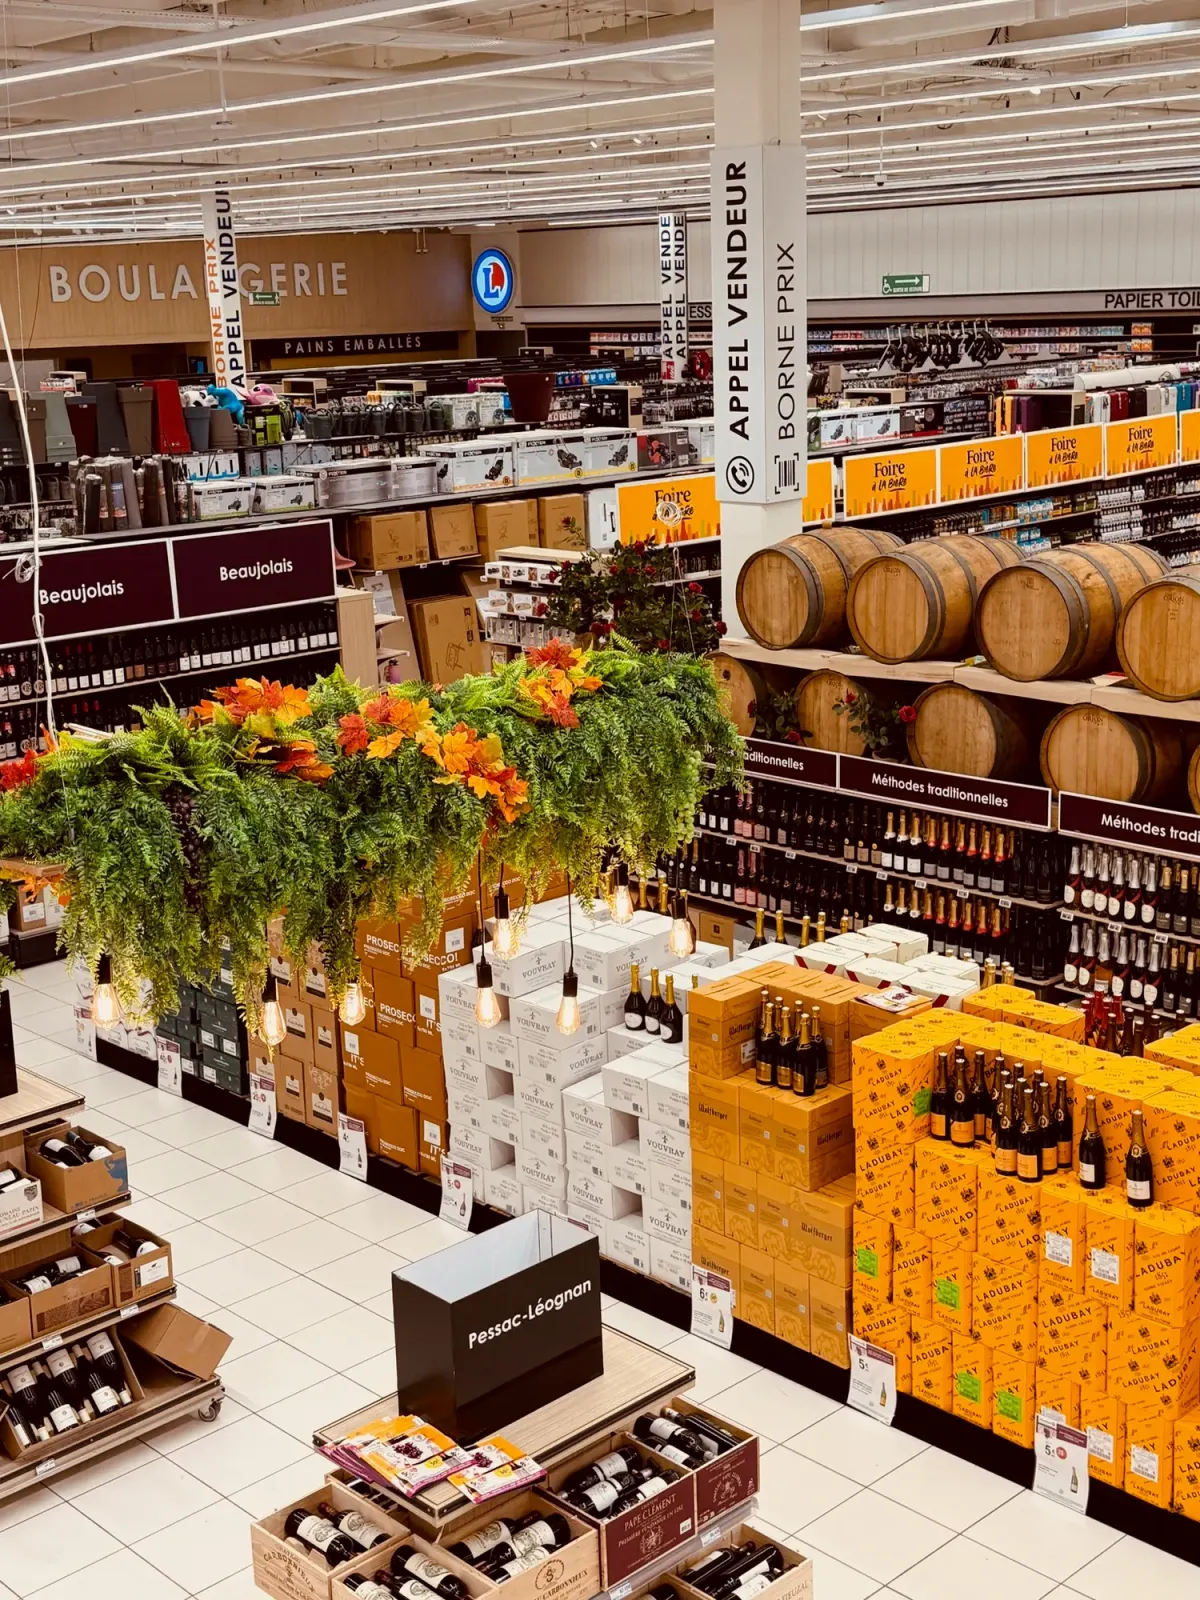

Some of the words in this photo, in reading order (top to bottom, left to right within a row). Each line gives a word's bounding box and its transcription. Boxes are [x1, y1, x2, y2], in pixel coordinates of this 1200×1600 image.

[214, 180, 238, 298] VENDEUR
[725, 160, 748, 327] VENDEUR
[205, 238, 219, 293] PRIX
[49, 262, 348, 303] BOULAGERIE
[776, 242, 795, 314] PRIX
[1104, 292, 1163, 309] PAPIER
[689, 305, 711, 319] ESS
[662, 293, 673, 359] APPEL
[674, 293, 687, 359] APPEL
[211, 306, 226, 388] BORNE
[226, 309, 246, 389] APPEL
[284, 341, 334, 354] PAINS
[344, 333, 422, 352] EMBALLÉS
[727, 339, 750, 441] APPEL
[777, 323, 796, 441] BORNE
[1128, 425, 1153, 441] Foire
[1050, 436, 1076, 453] Foire
[966, 448, 994, 465] Foire
[874, 460, 906, 479] Foire
[654, 487, 691, 504] Foire
[219, 558, 294, 581] Beaujolais
[39, 580, 124, 605] Beaujolais
[743, 751, 804, 771] aditionnelles
[871, 772, 926, 796] Méthodes
[927, 781, 1009, 808] traditionnelles
[1099, 814, 1164, 837] Méthodes
[366, 934, 400, 953] PROSEC
[521, 960, 557, 979] VOUVRAY
[426, 1018, 441, 1032] IT'S
[516, 1016, 551, 1033] VOUVRAY
[569, 1051, 604, 1071] VOUVRAY
[449, 1067, 479, 1083] VOUVRAY
[871, 1068, 903, 1087] LADUBAY
[520, 1091, 555, 1109] VOUVRAY
[863, 1100, 896, 1118] LADUBAY
[569, 1110, 604, 1129] VOUVRAY
[698, 1103, 728, 1121] Wolfberger
[454, 1136, 483, 1154] VOUVRAY
[646, 1139, 685, 1158] VOUVRAY
[859, 1147, 904, 1172] LADUBAY
[521, 1165, 557, 1183] VOUVRAY
[934, 1173, 967, 1190] LADUBAY
[1156, 1166, 1196, 1186] LADUBAY
[572, 1184, 604, 1205] VOUVRAY
[860, 1180, 892, 1198] LADUBAY
[999, 1195, 1034, 1213] LADUBAY
[926, 1206, 959, 1223] LADUBAY
[649, 1215, 688, 1237] VOUVRAY
[801, 1221, 833, 1242] Wolfberger
[990, 1229, 1025, 1245] LADUBAY
[893, 1250, 932, 1273] ADUBA
[1136, 1251, 1186, 1278] ADUBA
[976, 1279, 1024, 1302] LADUBAY
[467, 1278, 593, 1350] Pessac-Léognan
[978, 1312, 1013, 1329] LADUBAY
[1041, 1306, 1093, 1329] LADUBAY
[855, 1316, 898, 1336] LADUBAY
[912, 1342, 952, 1364] ADUBA
[1043, 1340, 1080, 1355] LADUBAY
[1131, 1338, 1171, 1355] LADUBAY
[1122, 1372, 1160, 1388] LADUBAY
[624, 1515, 641, 1532] PAPE
